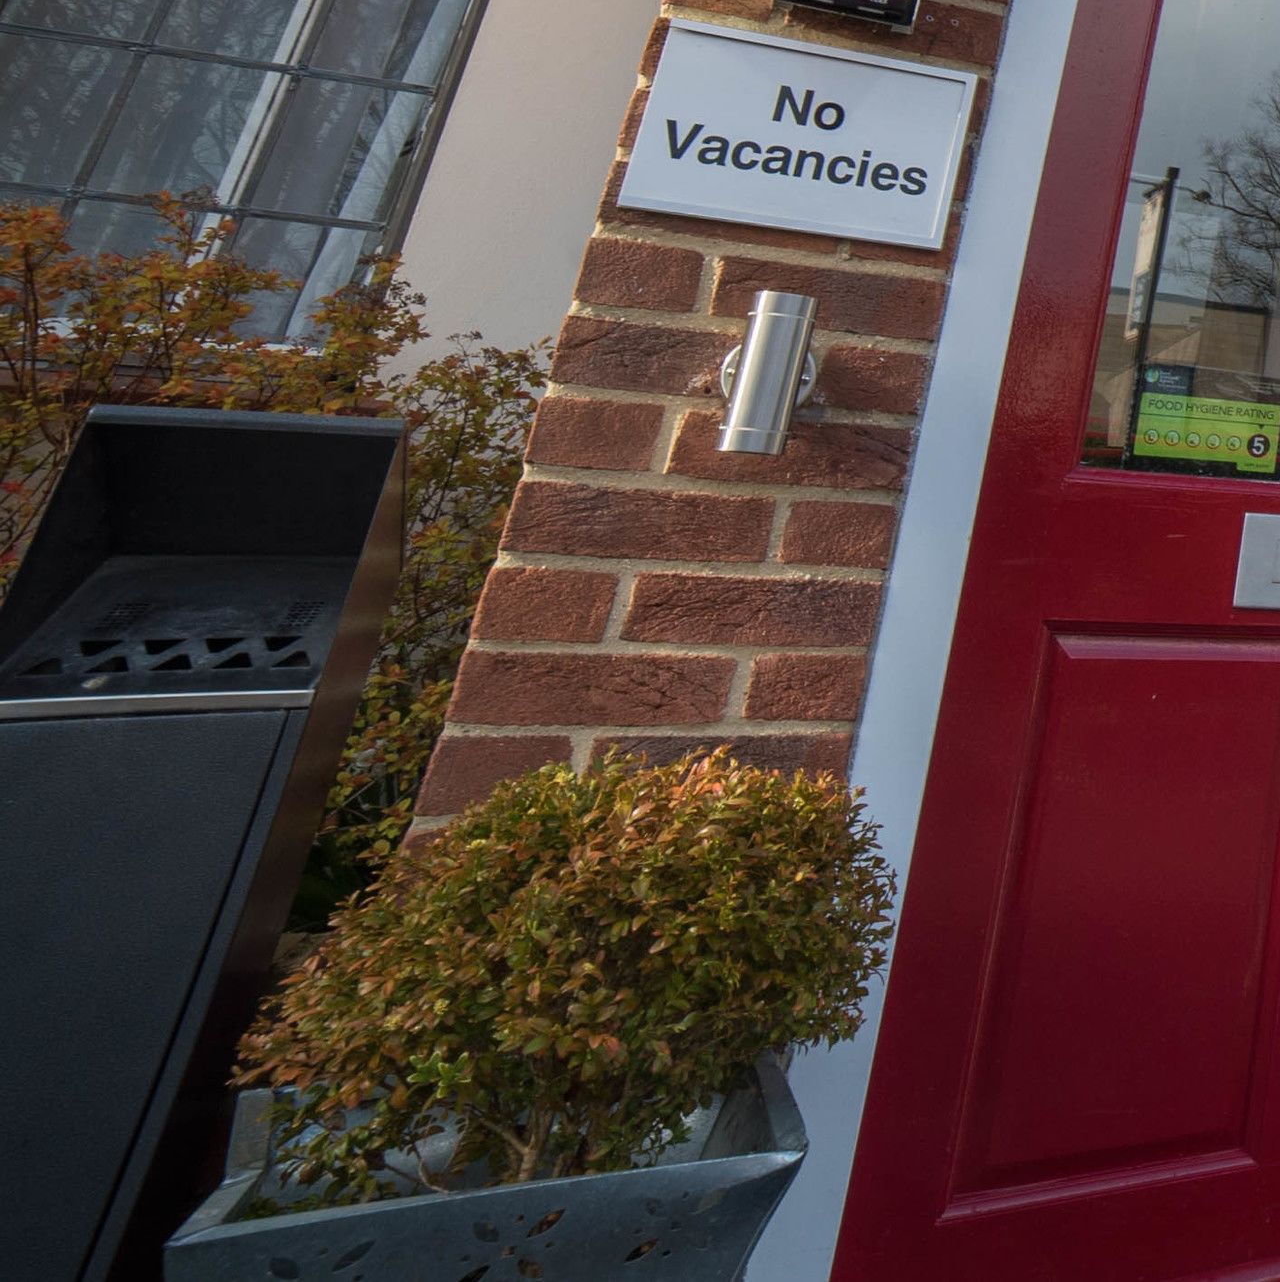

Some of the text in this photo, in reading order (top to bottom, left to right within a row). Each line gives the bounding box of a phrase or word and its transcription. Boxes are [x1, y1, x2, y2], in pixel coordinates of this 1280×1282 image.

[771, 84, 846, 131] No
[666, 119, 928, 196] Vacancies
[1147, 398, 1276, 420] FOOD HYGIENE RATING
[1251, 436, 1265, 455] 5
